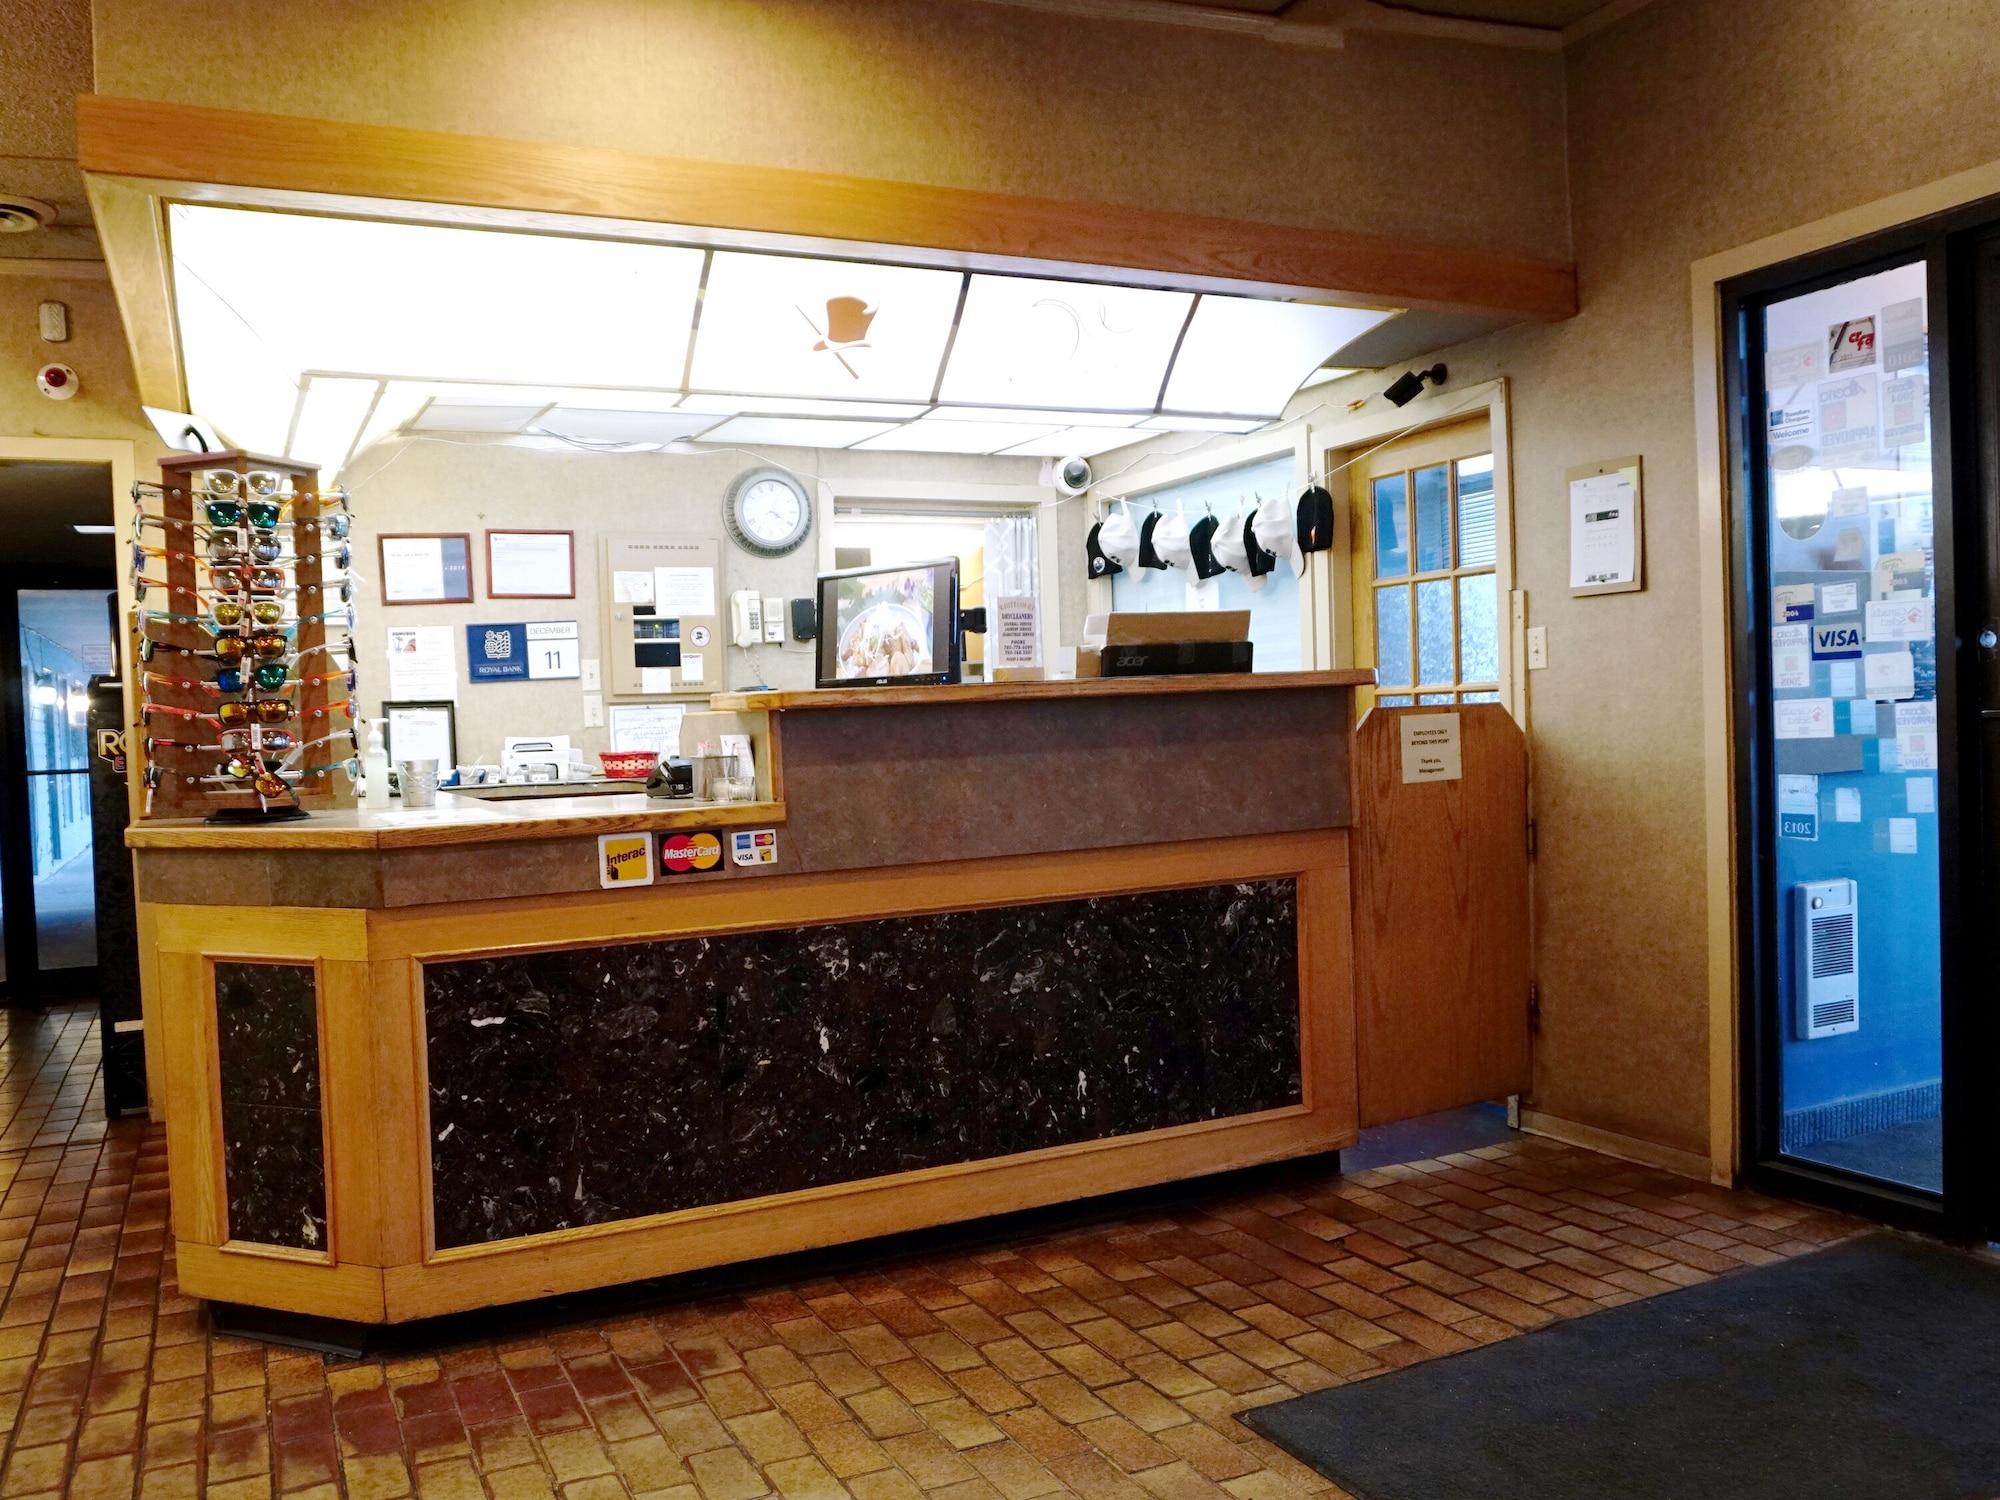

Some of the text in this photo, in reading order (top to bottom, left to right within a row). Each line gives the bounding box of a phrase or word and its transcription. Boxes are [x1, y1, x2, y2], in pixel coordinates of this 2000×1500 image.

[1772, 427, 1810, 439] Welcome
[529, 627, 571, 635] DECEMBER
[1818, 629, 1860, 647] VISA
[544, 650, 561, 670] 11
[1116, 656, 1148, 667] acer
[479, 665, 522, 674] ROYAL BANK
[607, 847, 646, 866] Interac
[664, 845, 720, 860] MasterCard
